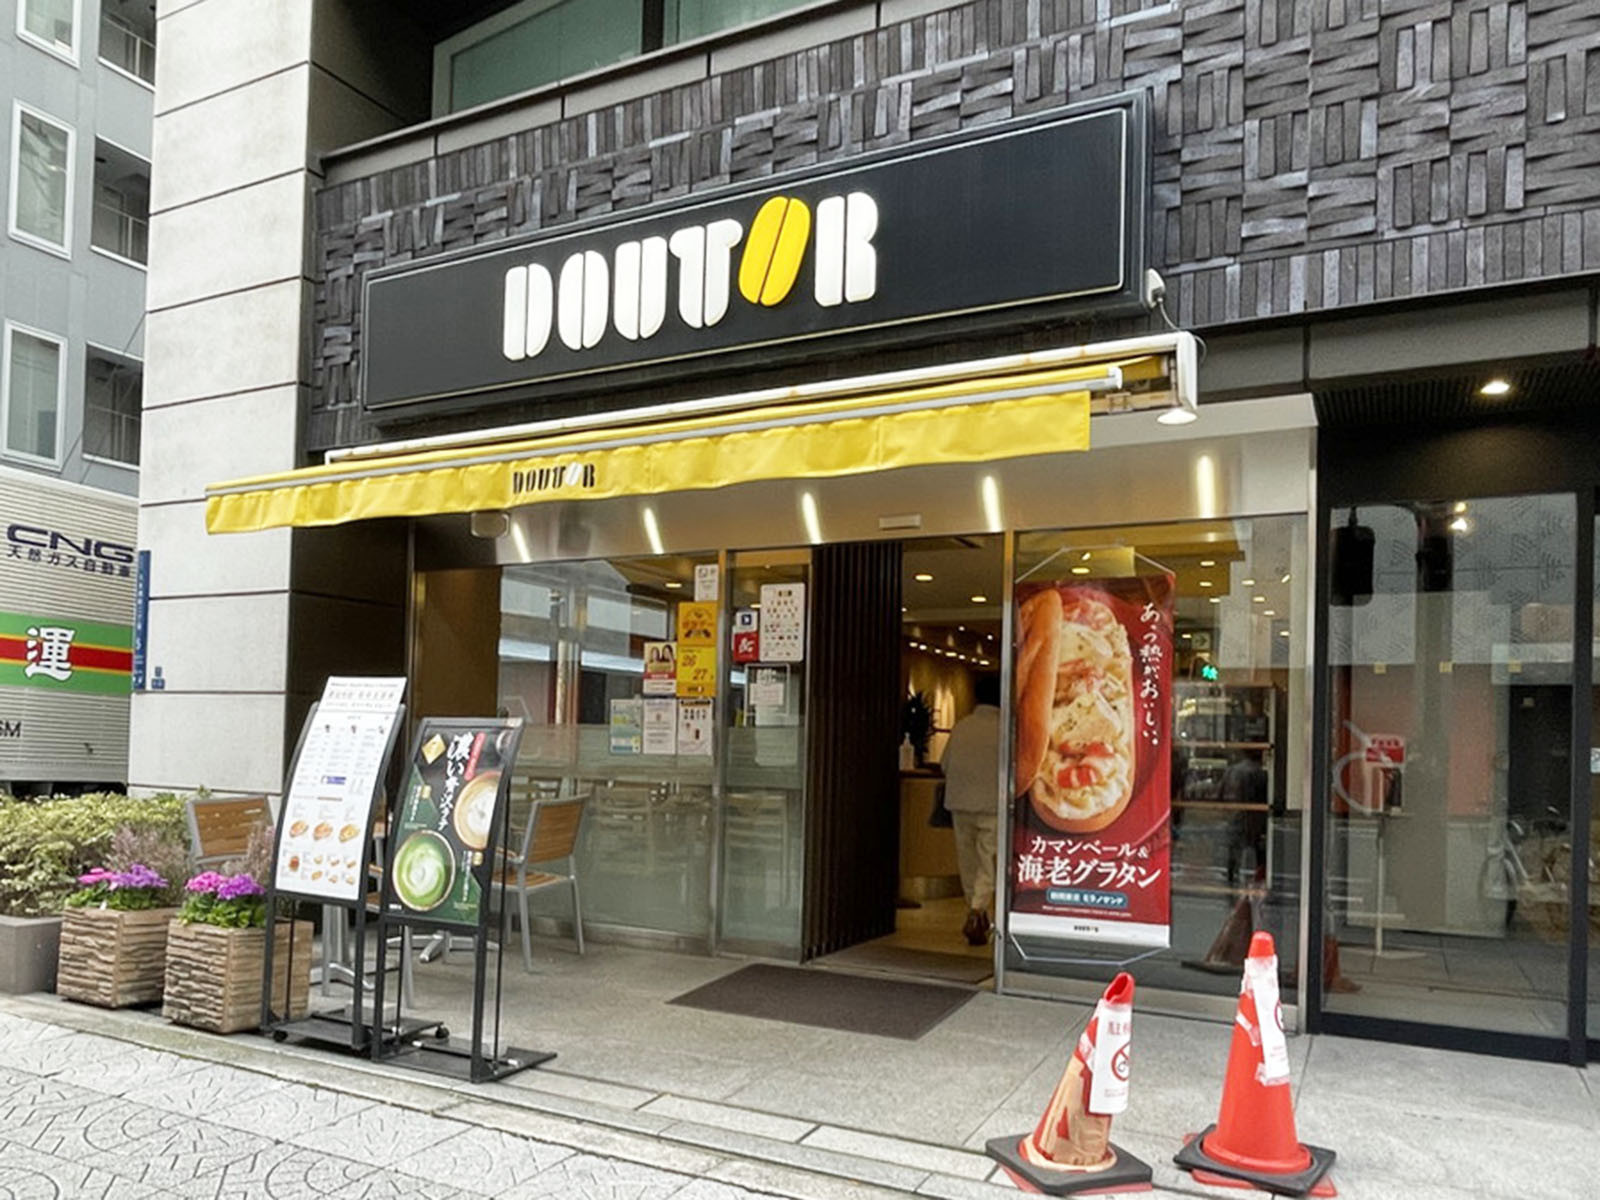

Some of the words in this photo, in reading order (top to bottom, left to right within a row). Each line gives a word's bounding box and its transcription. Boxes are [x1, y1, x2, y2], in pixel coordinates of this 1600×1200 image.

[503, 192, 878, 361] DOUTOR
[513, 463, 596, 495] DOUTOR
[7, 524, 134, 564] CNG
[25, 627, 76, 681] 運
[1017, 853, 1162, 889] 海老グラタン
